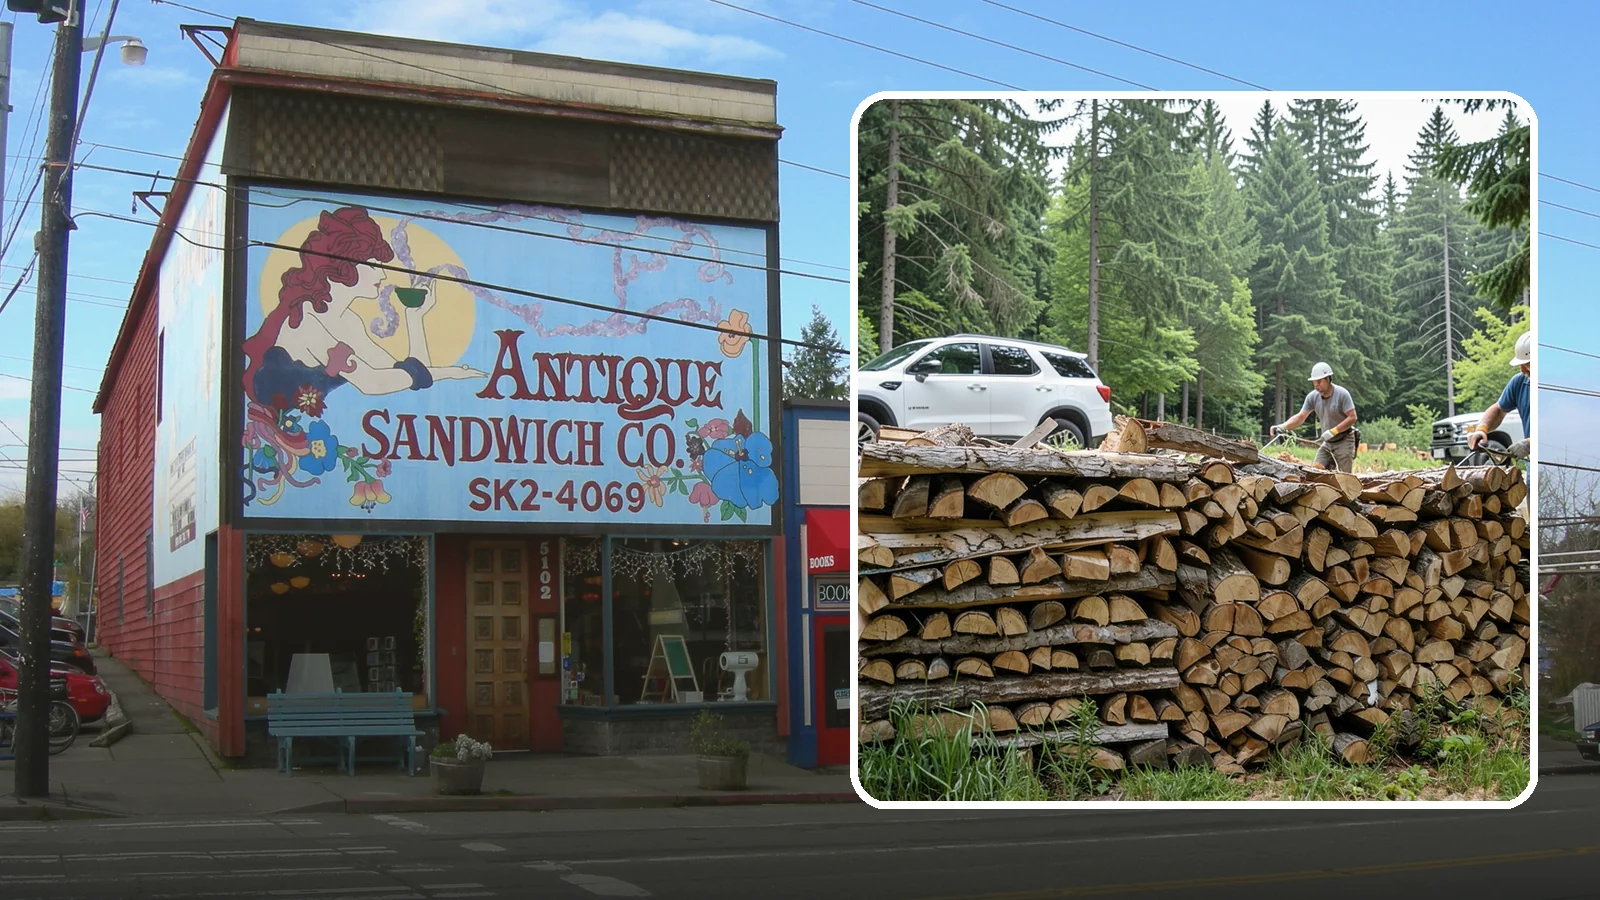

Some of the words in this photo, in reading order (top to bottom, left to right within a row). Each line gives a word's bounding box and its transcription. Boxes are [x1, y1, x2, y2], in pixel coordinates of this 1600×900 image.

[476, 329, 724, 420] ANTIQUE
[361, 408, 604, 468] SANDWICH
[617, 421, 685, 469] CO.
[468, 476, 646, 514] SK2-4069
[540, 542, 551, 599] 5102
[809, 555, 835, 569] BOOKS
